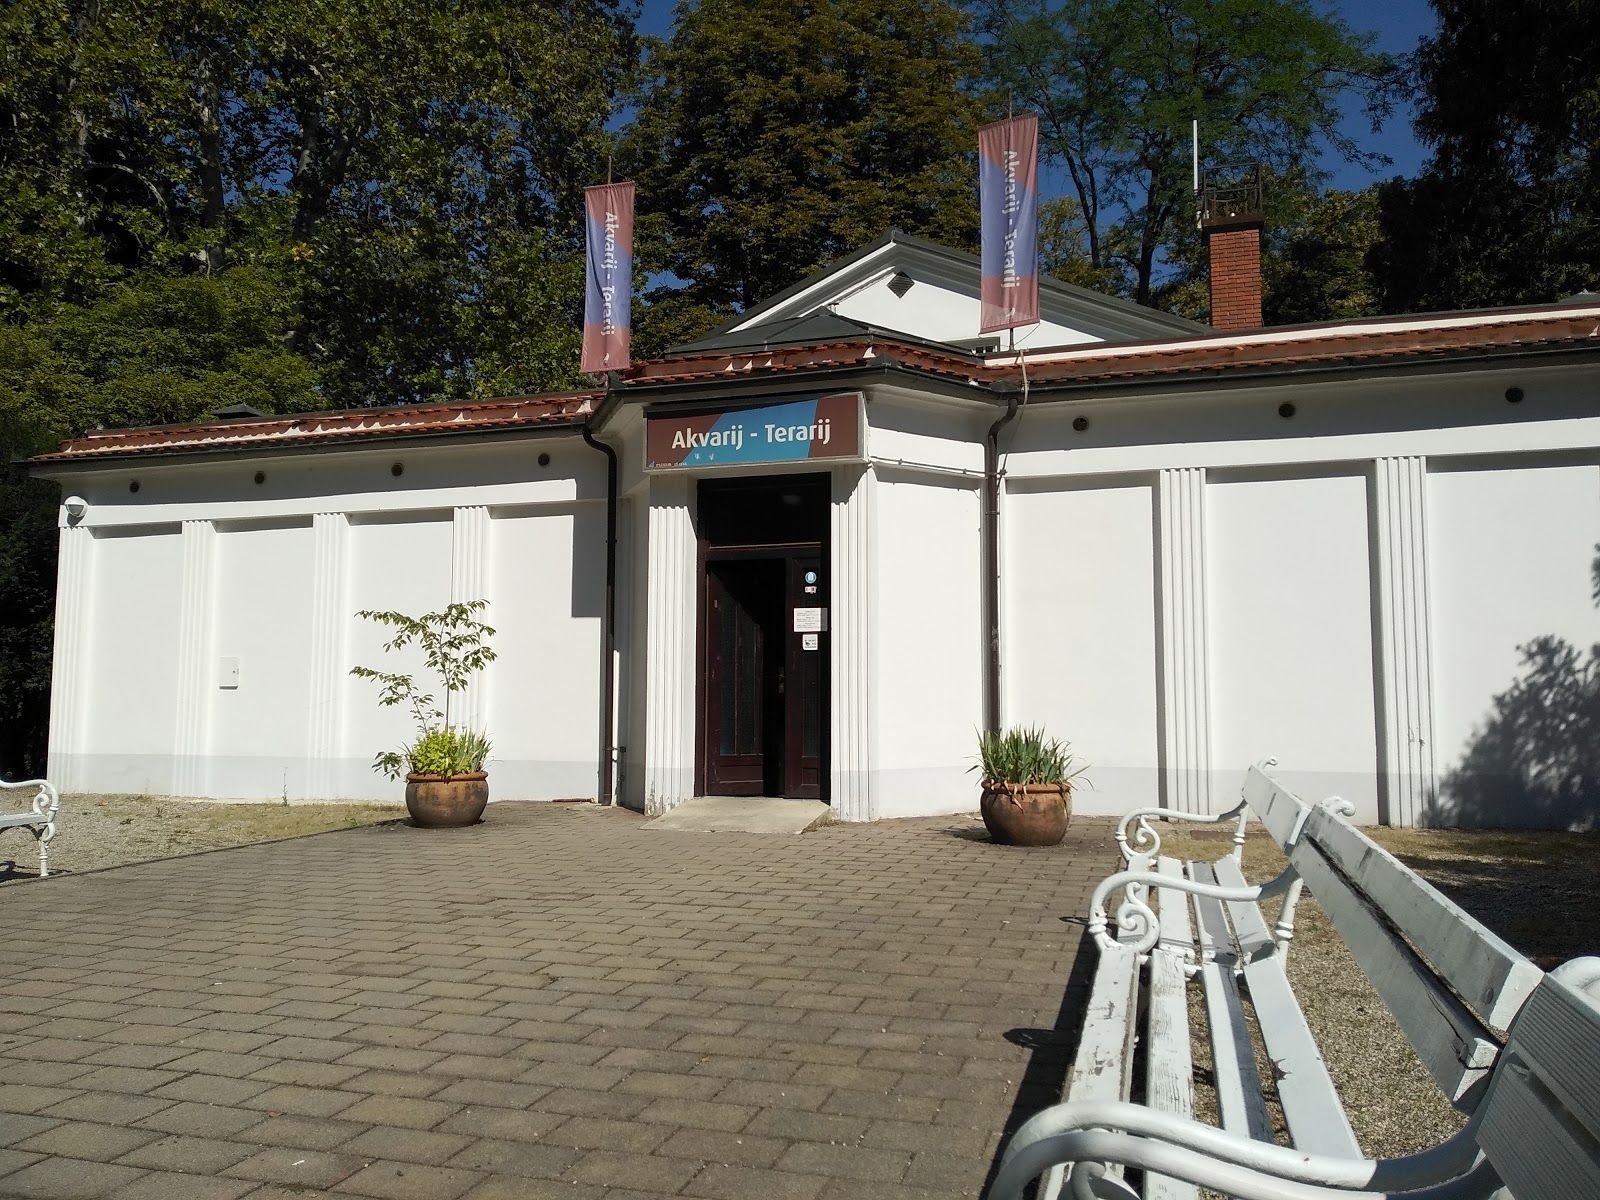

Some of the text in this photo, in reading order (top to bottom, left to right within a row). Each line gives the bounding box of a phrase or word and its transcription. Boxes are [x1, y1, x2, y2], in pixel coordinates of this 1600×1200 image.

[601, 211, 619, 270] Akvarij
[1001, 150, 1020, 288] Akvarij - Terarij
[601, 285, 615, 336] Terarij
[671, 424, 743, 450] Akvarij
[764, 418, 831, 445] Terarij
